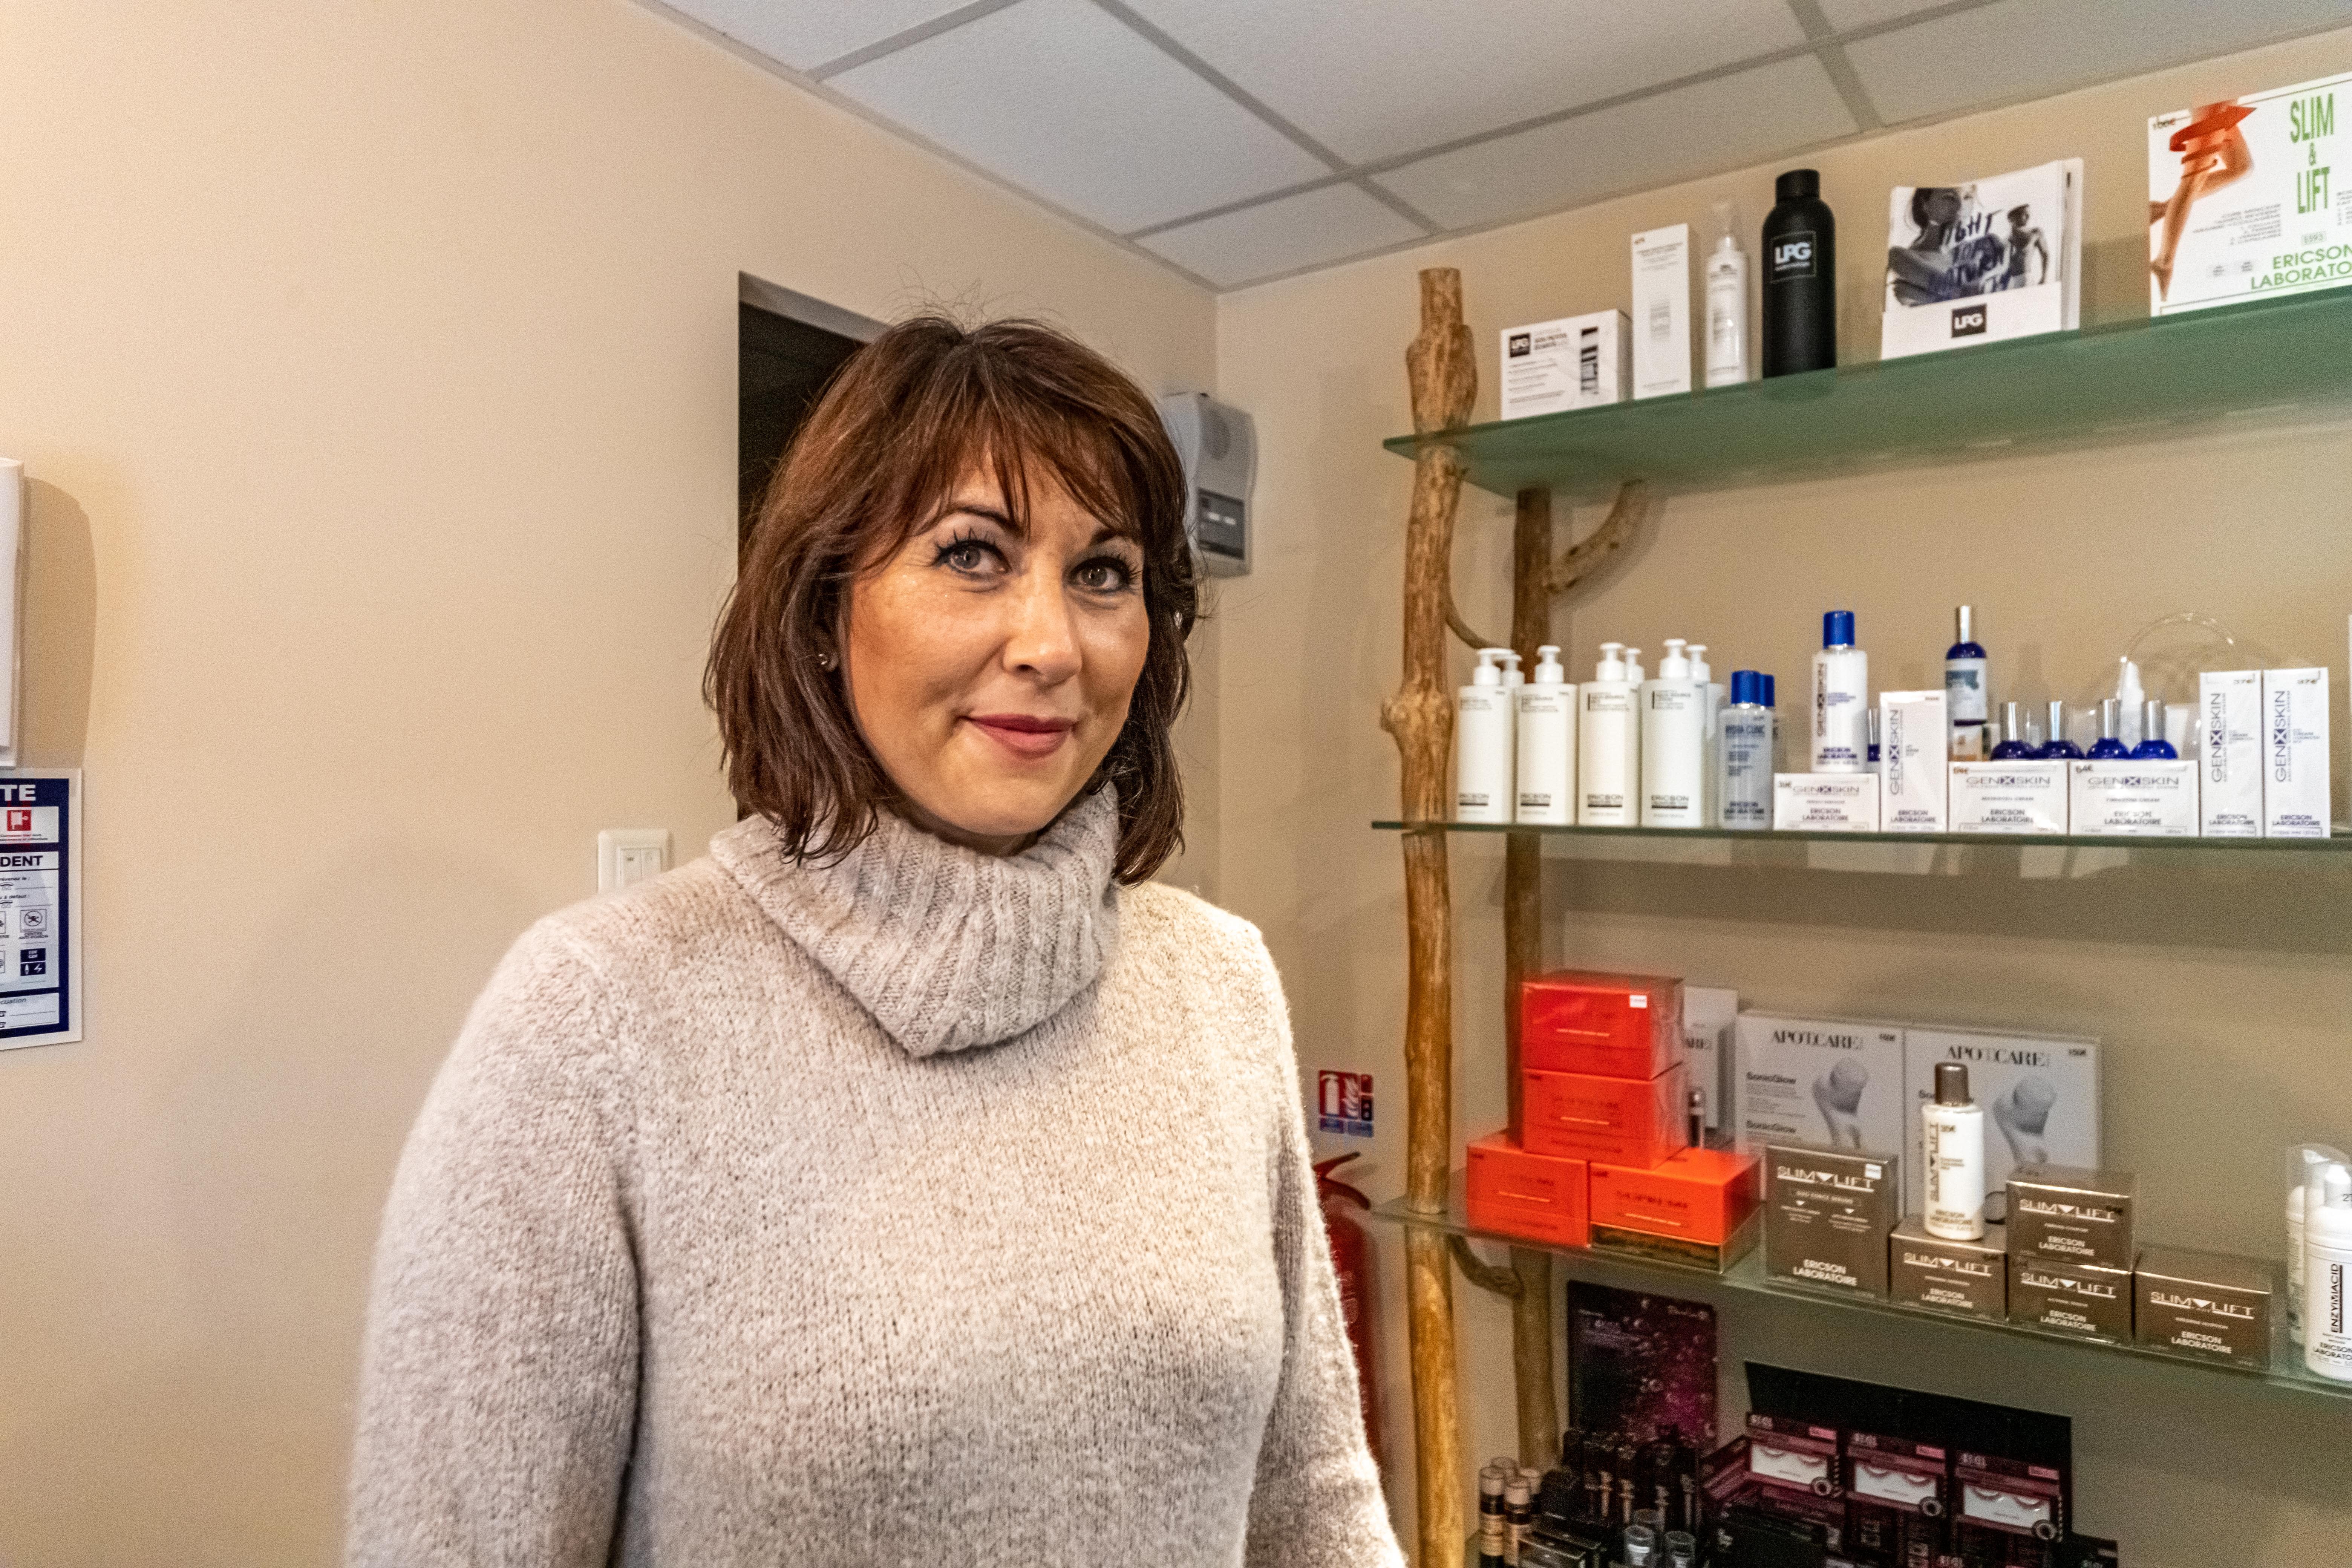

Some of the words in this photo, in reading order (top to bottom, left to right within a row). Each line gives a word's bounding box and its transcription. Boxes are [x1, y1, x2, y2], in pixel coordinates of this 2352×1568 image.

[2290, 93, 2334, 143] SLIM
[2308, 142, 2316, 165] &
[2297, 166, 2330, 214] LIFT
[1775, 242, 1811, 264] LPG
[2272, 244, 2352, 269] ERICSON
[2251, 261, 2352, 290] LABORATO
[1955, 313, 1983, 330] LPG
[2039, 1242, 2095, 1256] LABORATOIRE
[2048, 1235, 2085, 1247] ERICSON
[1803, 1259, 1846, 1274] ERICSON
[1793, 1266, 1857, 1286] LABORATOIRE
[1929, 1288, 1965, 1300] ERICSON
[2331, 1263, 2339, 1333] ENZYMACID
[2040, 1315, 2096, 1331] LABORATOIRE
[2049, 1310, 2087, 1322] ERICSON
[2171, 1337, 2233, 1354] LABORATOIRE
[2181, 1331, 2222, 1344] ERICSON
